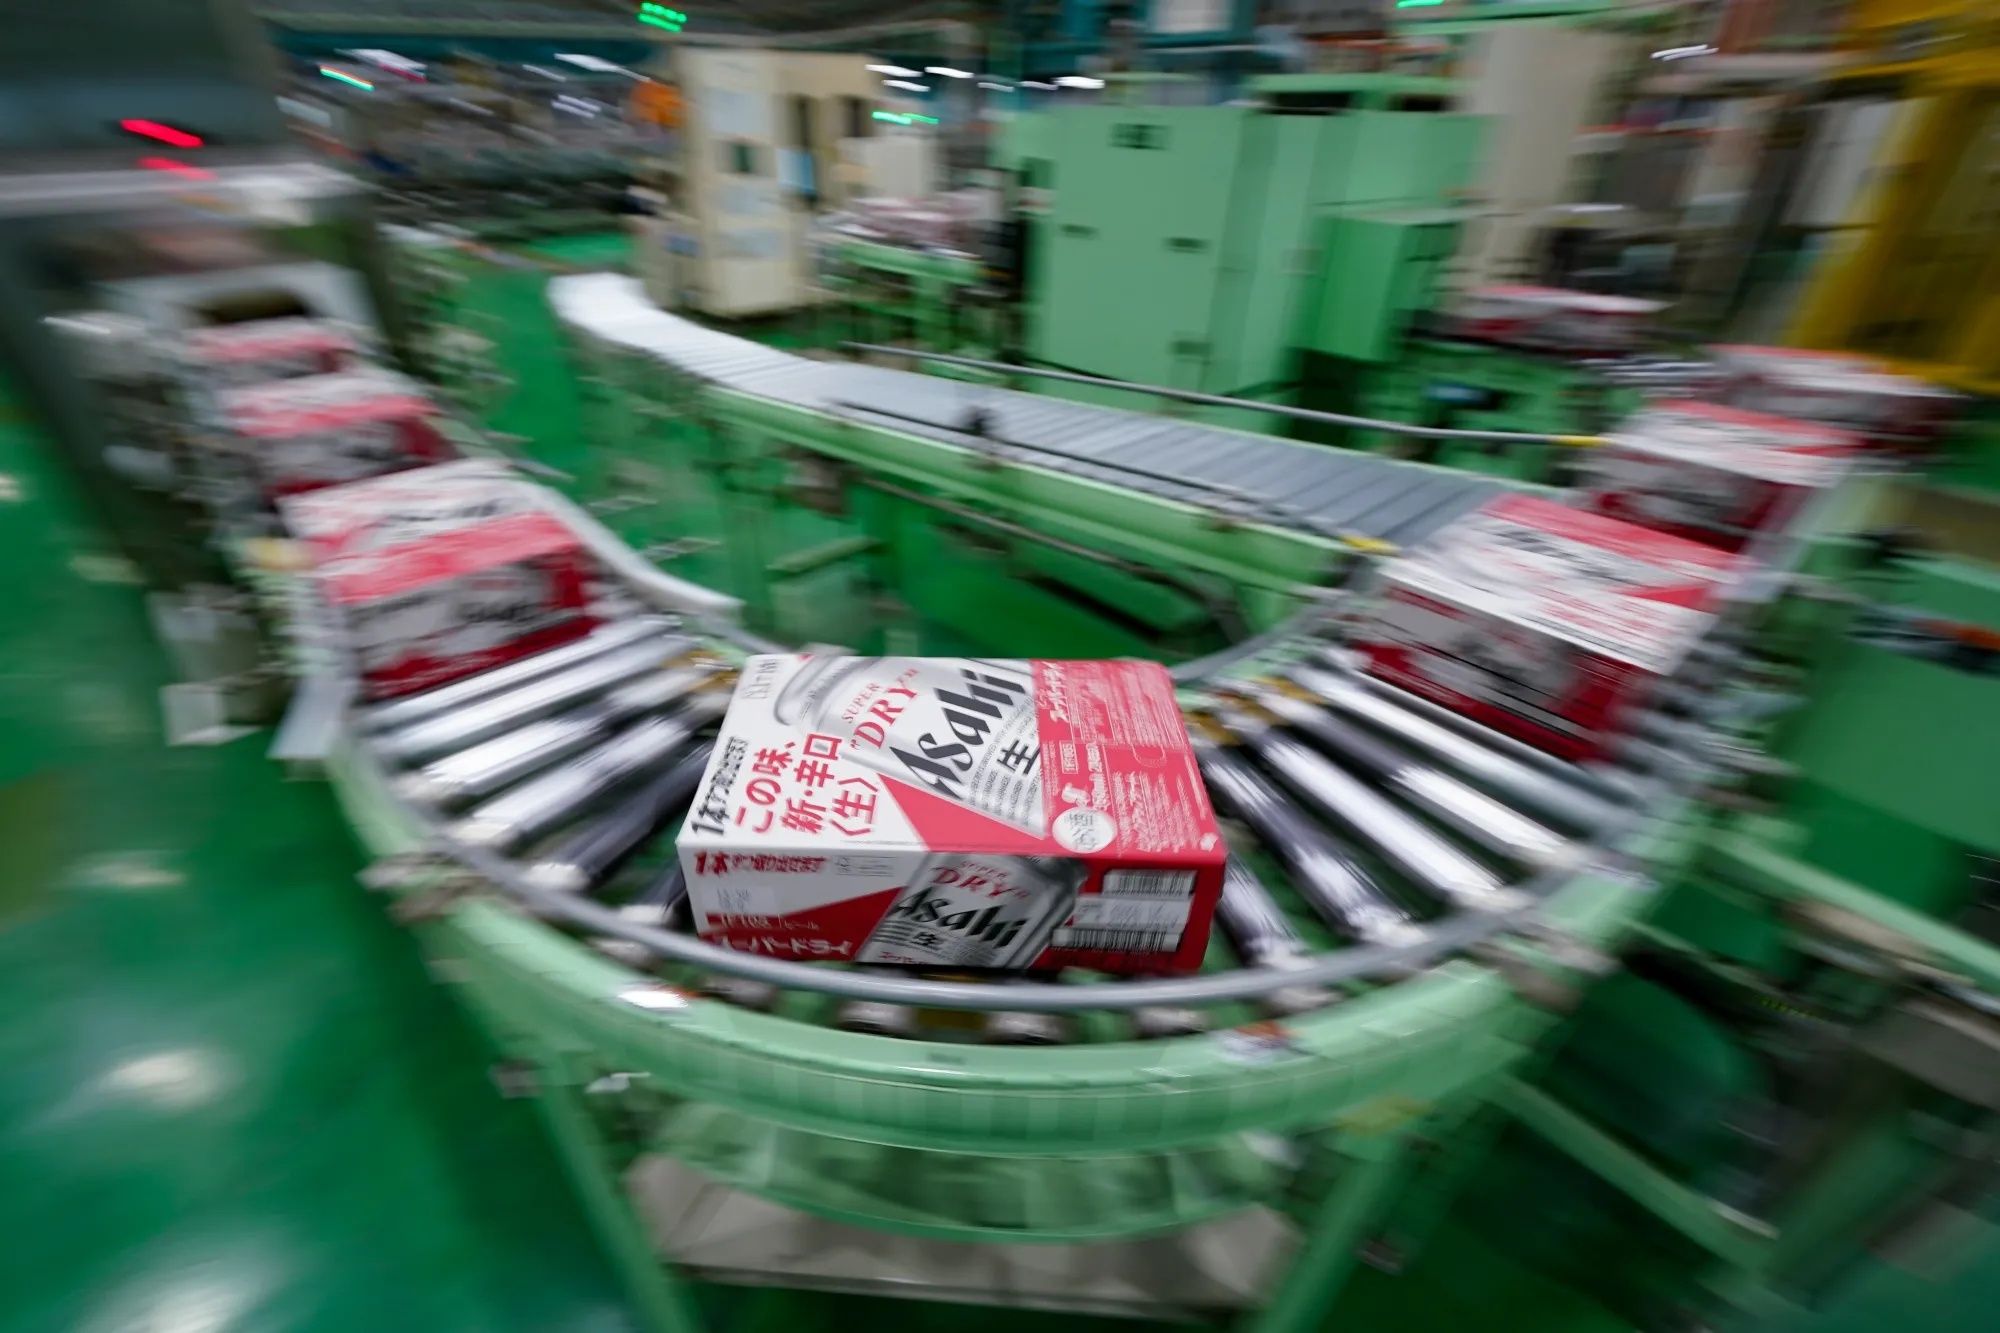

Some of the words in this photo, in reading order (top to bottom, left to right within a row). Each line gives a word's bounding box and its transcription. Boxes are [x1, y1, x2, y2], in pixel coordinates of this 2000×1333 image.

[842, 682, 881, 724] SUPER
[889, 668, 1026, 801] Asahi
[734, 741, 796, 833] この味、
[780, 733, 842, 835] 新・辛口
[997, 738, 1040, 775] 生
[889, 886, 1031, 949] Asahi
